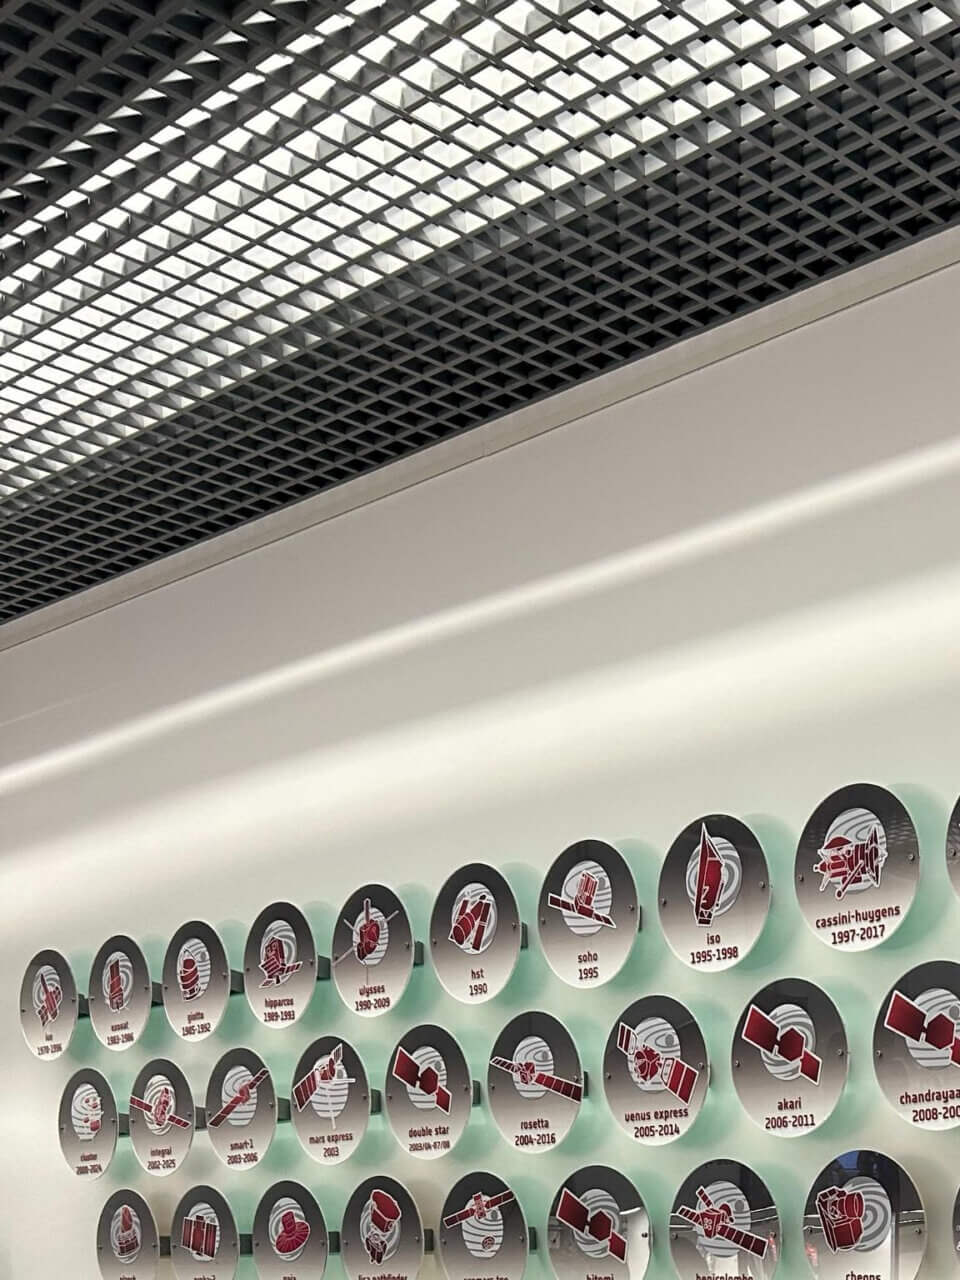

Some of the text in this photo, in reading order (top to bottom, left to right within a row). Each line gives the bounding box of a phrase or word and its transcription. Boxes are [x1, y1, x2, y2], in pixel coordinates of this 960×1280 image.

[815, 904, 901, 928] cassini-huygens
[706, 933, 721, 945] iso
[831, 925, 886, 945] 1997-2017
[578, 951, 598, 964] soho
[690, 946, 738, 964] 1995-1998
[471, 968, 485, 980] hst
[578, 967, 599, 980] 1995
[359, 984, 385, 996] ulysses
[469, 983, 488, 996] 1990
[355, 997, 390, 1012] 1990-2009
[777, 1097, 802, 1111] akari
[624, 1107, 689, 1122] venus express
[520, 1118, 550, 1130] rosetta
[765, 1113, 816, 1130] 2006-2011
[408, 1125, 450, 1138] double star
[634, 1126, 680, 1139] 2005-2014
[309, 1132, 353, 1145] mars express
[515, 1132, 556, 1146] 2004-2016
[323, 1146, 339, 1158] 2003
